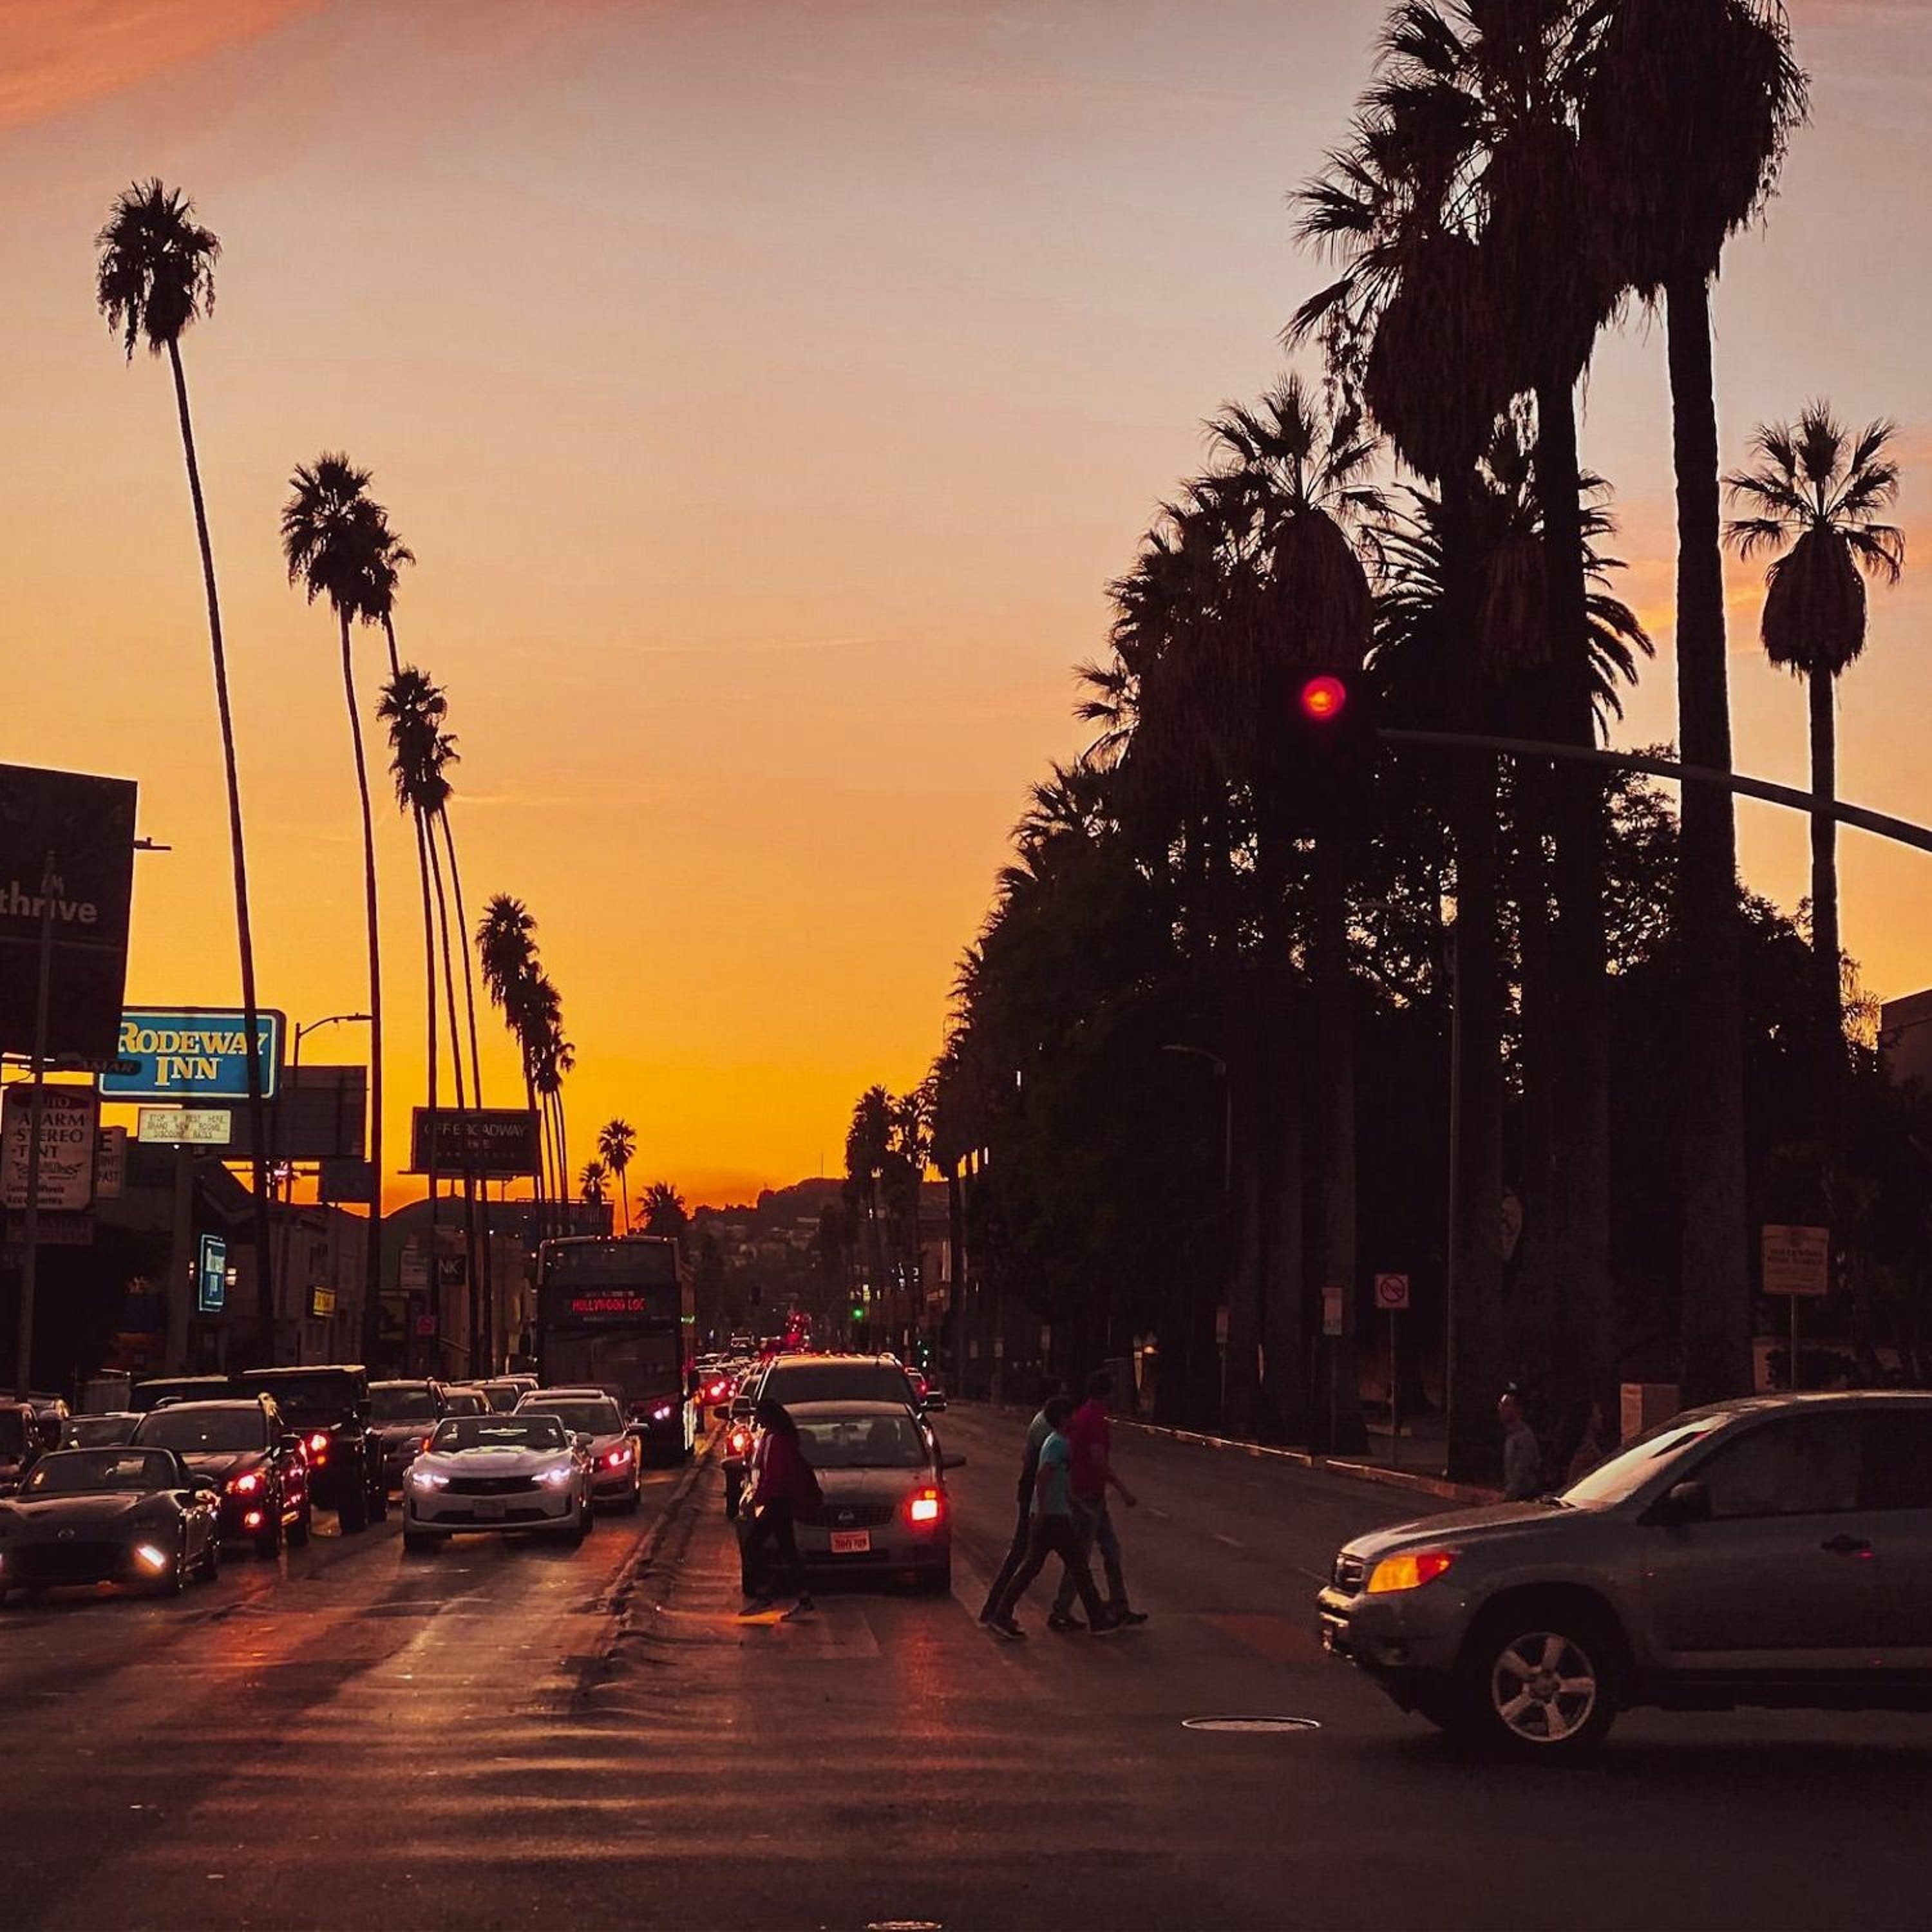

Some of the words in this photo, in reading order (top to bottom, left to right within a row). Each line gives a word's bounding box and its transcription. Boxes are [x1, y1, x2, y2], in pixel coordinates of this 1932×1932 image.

[0, 880, 98, 923] thrive
[117, 1021, 269, 1056] RODEWAY
[154, 1057, 220, 1086] INN
[18, 1113, 85, 1126] AARM
[16, 1128, 84, 1143] SEREO
[18, 1145, 60, 1158] TNT
